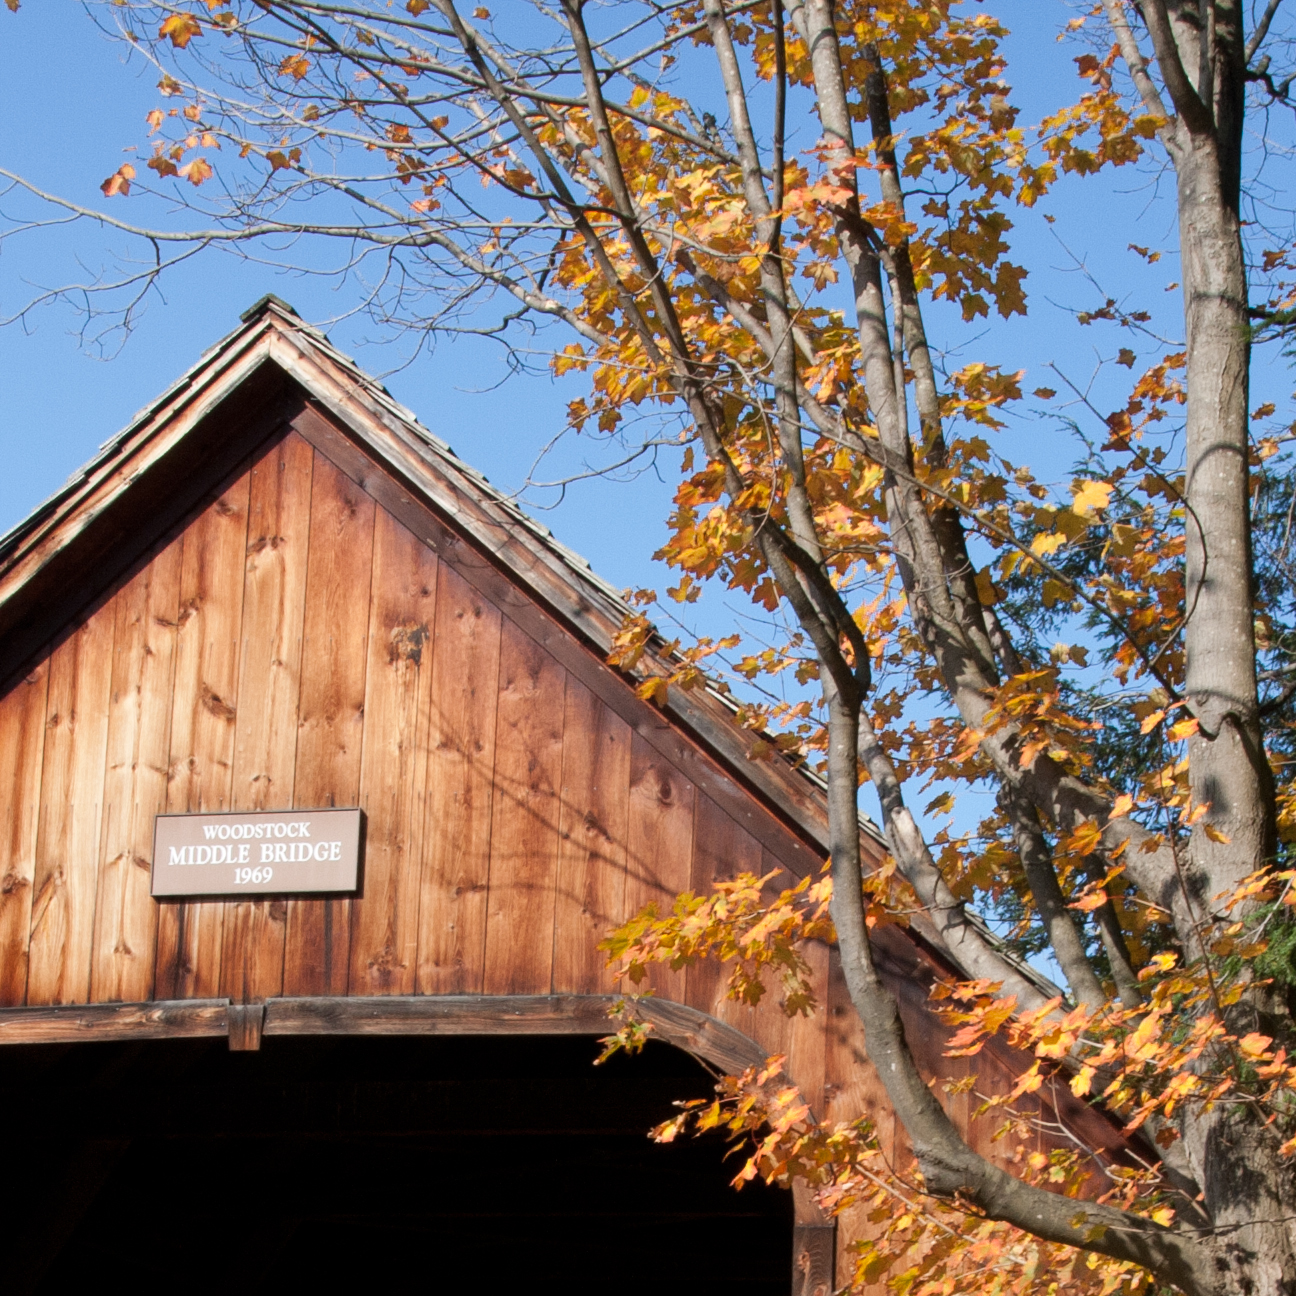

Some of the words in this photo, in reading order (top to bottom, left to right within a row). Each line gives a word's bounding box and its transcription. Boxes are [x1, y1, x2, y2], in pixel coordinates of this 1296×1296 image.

[202, 821, 311, 840] WOODSTOCK
[168, 843, 250, 866] MIDDLE
[260, 841, 342, 863] BRIDGE
[234, 866, 273, 884] 1969
